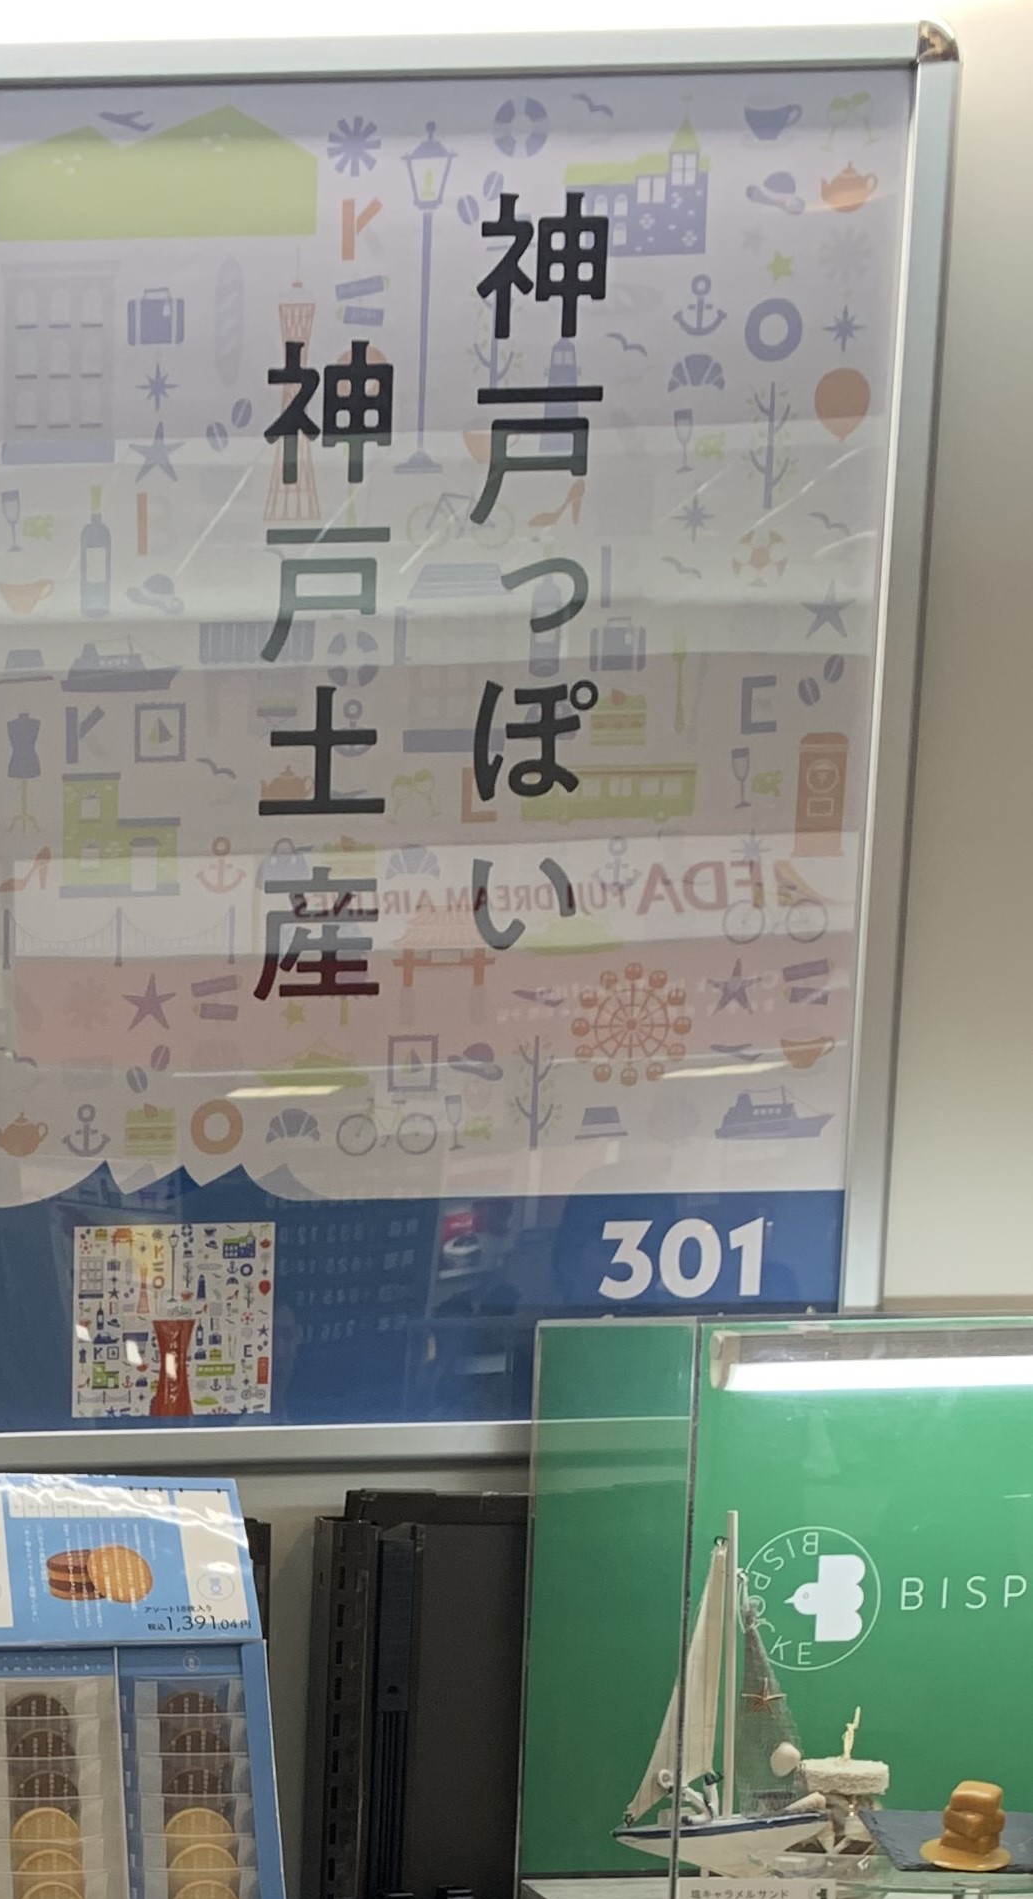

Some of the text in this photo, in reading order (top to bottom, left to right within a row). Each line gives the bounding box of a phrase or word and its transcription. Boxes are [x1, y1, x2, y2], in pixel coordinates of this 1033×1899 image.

[254, 340, 395, 999] 神戸土産
[469, 192, 610, 950] 神戸っぽい
[598, 1220, 768, 1299] 301
[901, 1575, 1027, 1611] BISP
